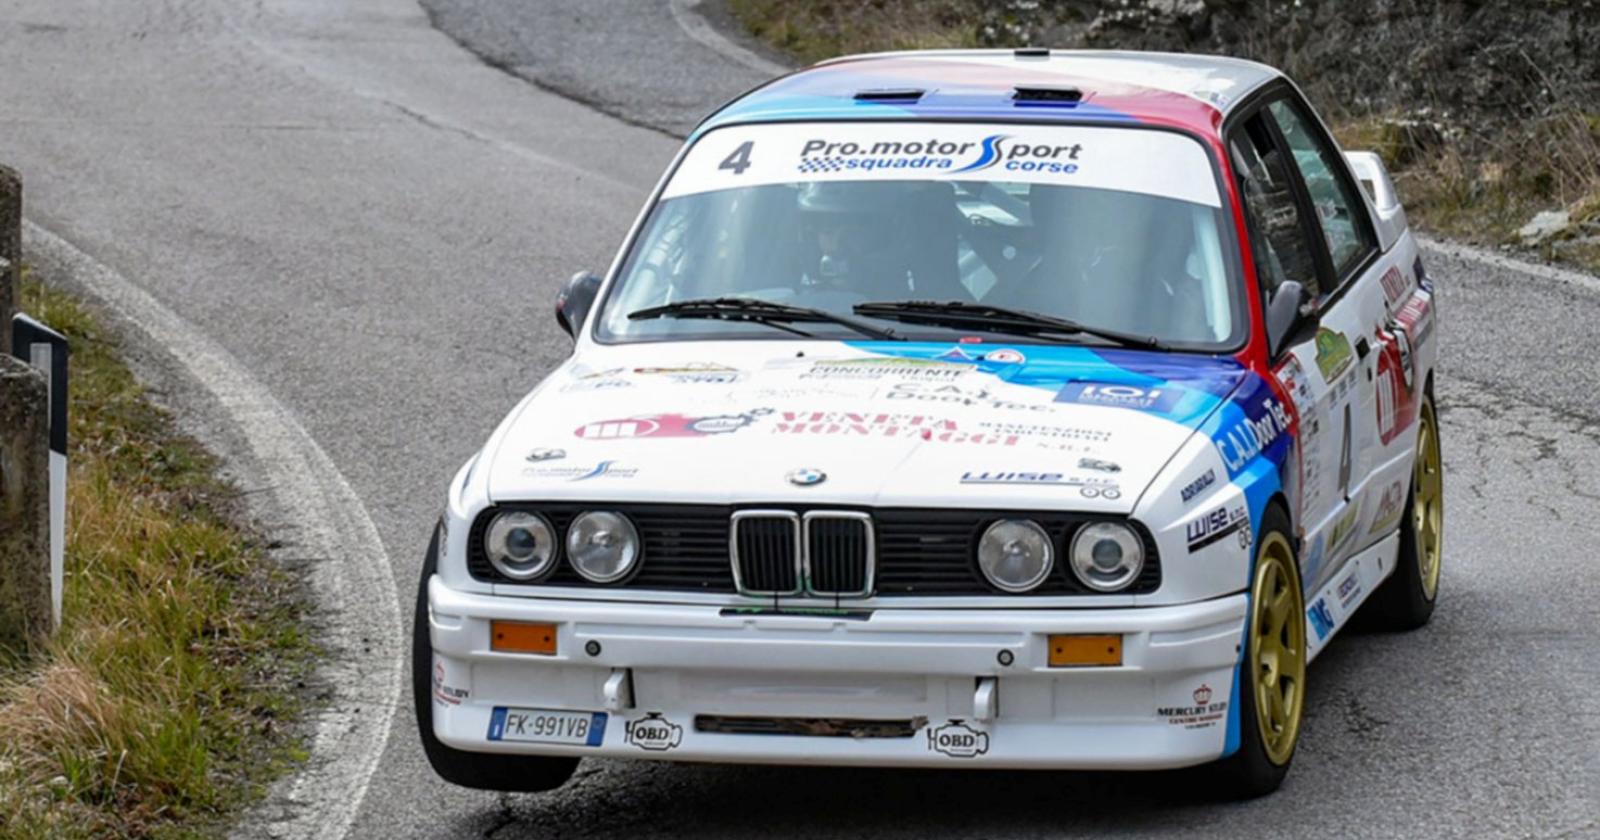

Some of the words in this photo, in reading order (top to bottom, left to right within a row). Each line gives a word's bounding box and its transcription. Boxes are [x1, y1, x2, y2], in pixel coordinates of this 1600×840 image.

[718, 140, 754, 174] 4
[846, 156, 953, 171] squadra
[1005, 159, 1079, 174] corse
[782, 411, 958, 431] VENETA
[772, 423, 1018, 446] MONTAGGI
[505, 714, 589, 738] FK-991VB
[635, 726, 670, 741] OBD
[939, 733, 975, 748] OBD
